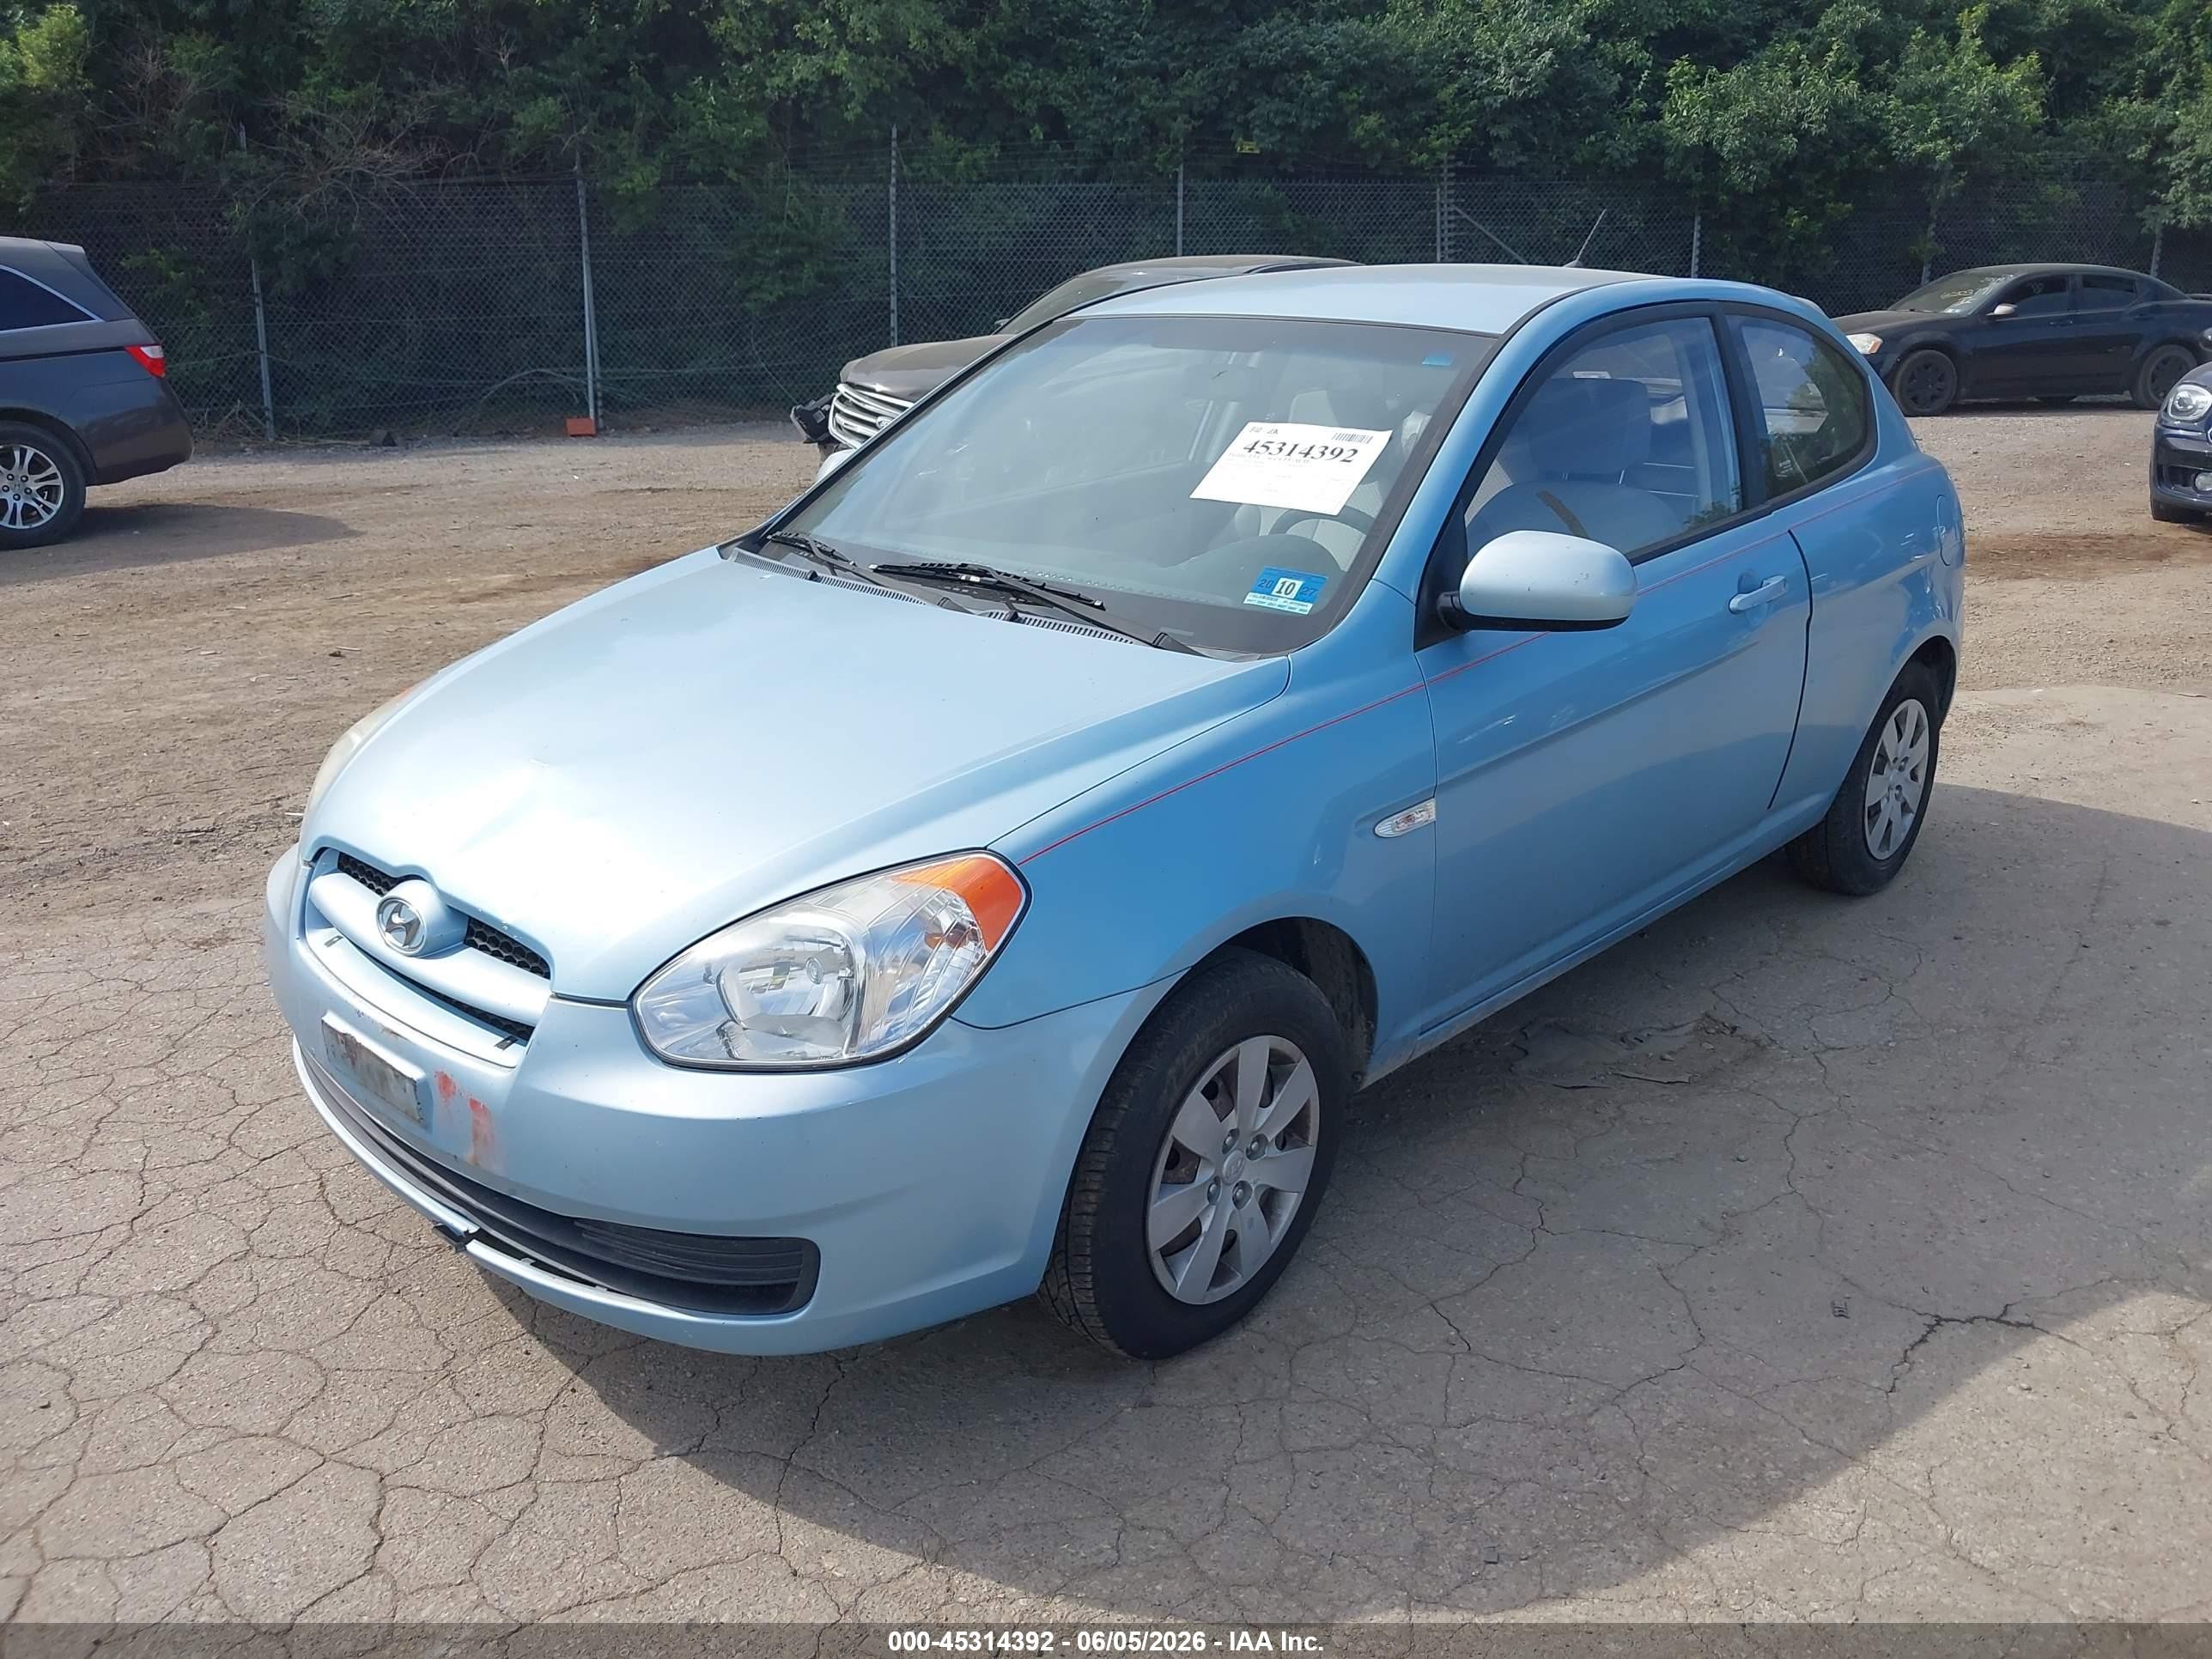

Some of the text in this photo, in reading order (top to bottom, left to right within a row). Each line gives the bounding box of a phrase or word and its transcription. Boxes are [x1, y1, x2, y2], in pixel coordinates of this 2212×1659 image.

[1243, 440, 1359, 463] 45314392
[1258, 578, 1318, 597] 20 10 27
